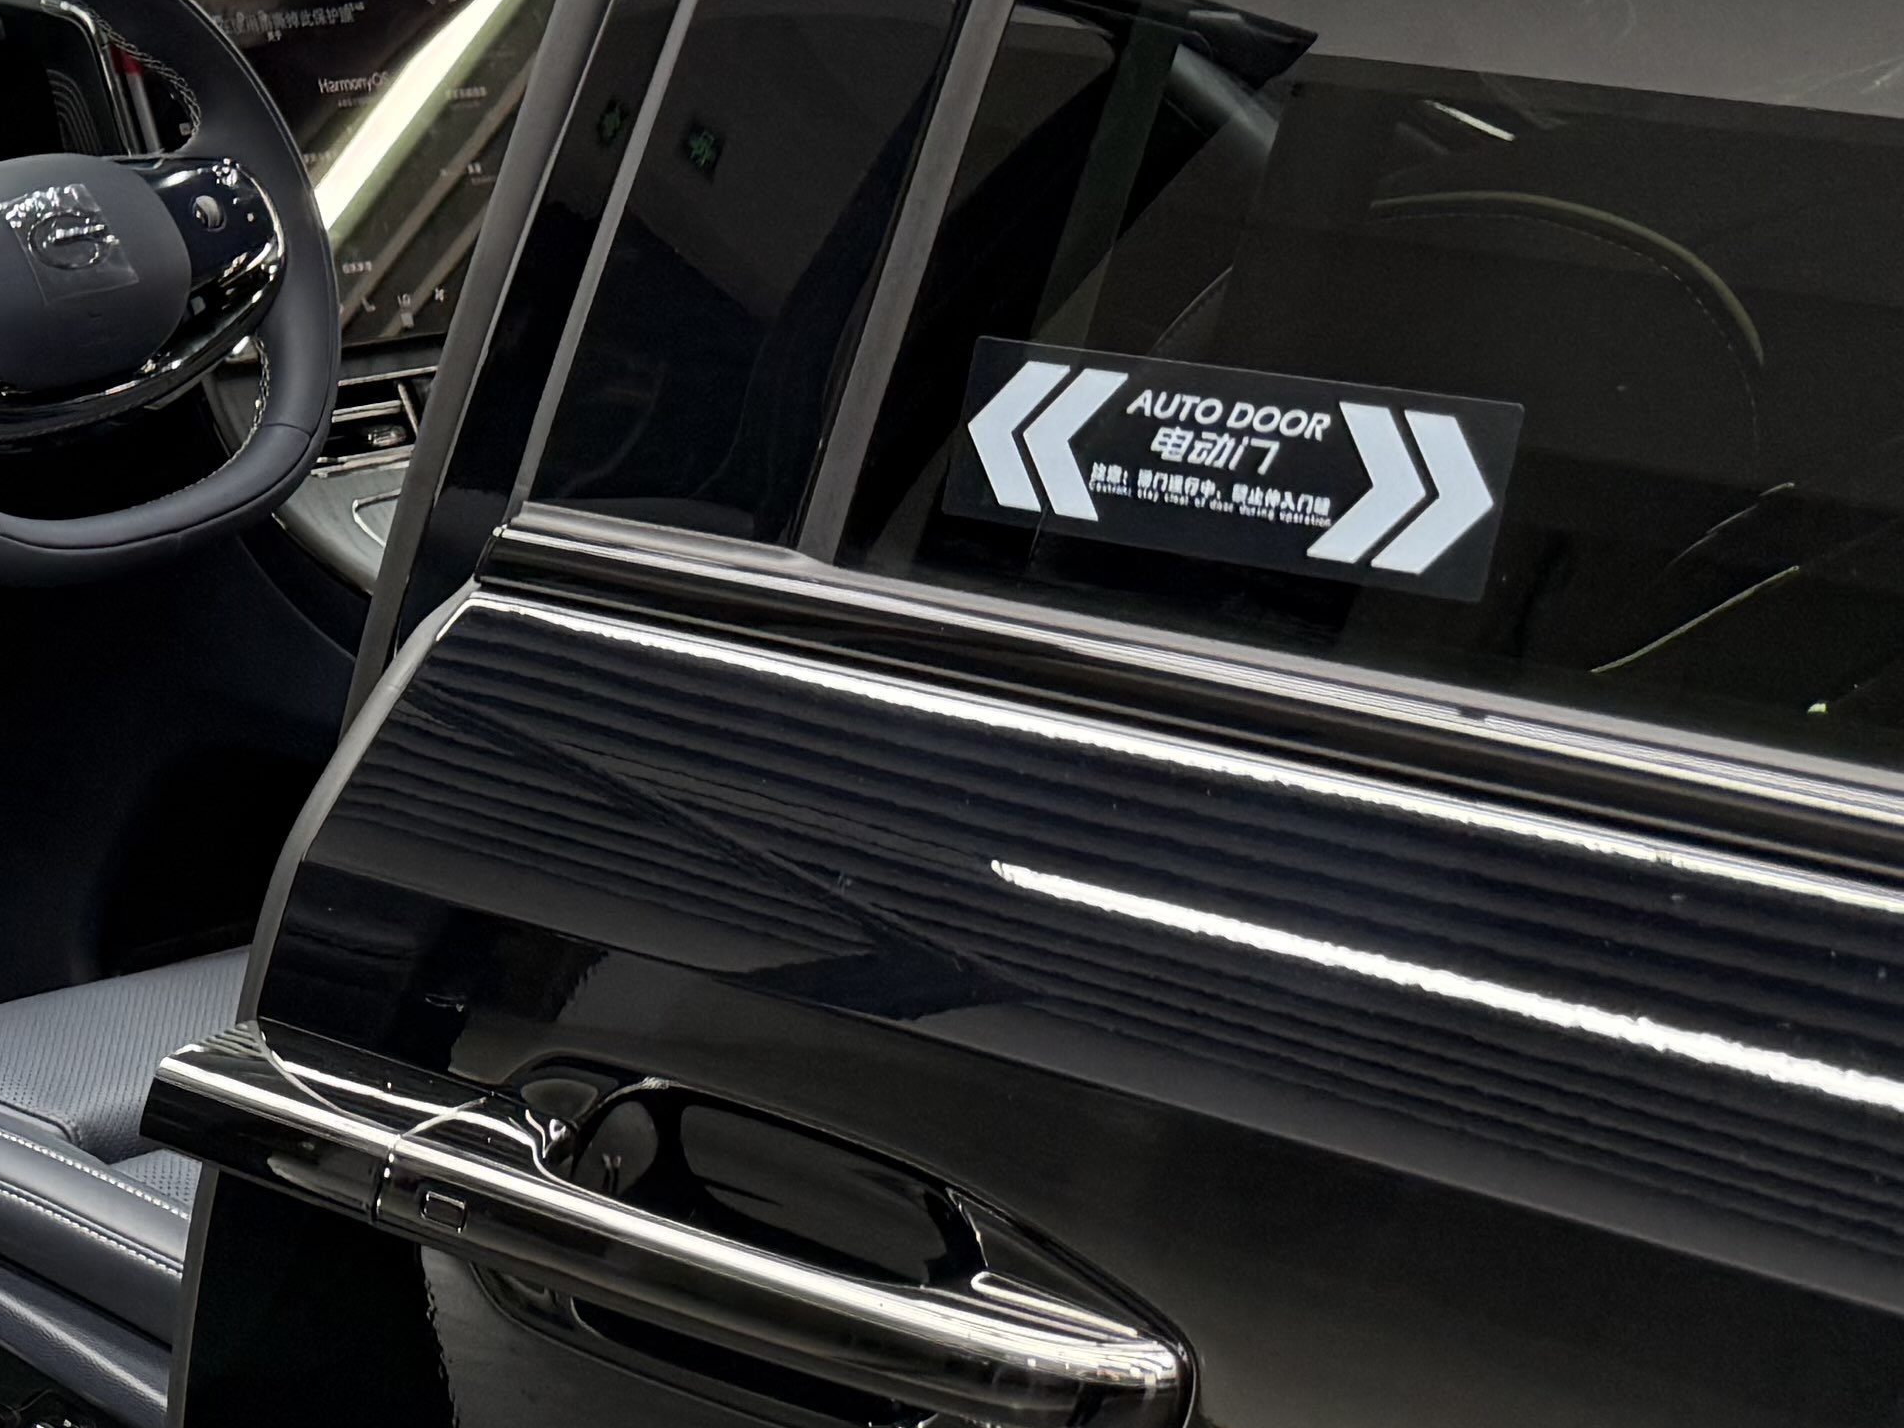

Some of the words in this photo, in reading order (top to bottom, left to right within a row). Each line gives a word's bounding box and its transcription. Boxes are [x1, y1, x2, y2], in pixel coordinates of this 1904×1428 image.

[1126, 389, 1224, 426] AUTO
[1226, 401, 1332, 442] DOOR
[1150, 426, 1281, 476] 电动门
